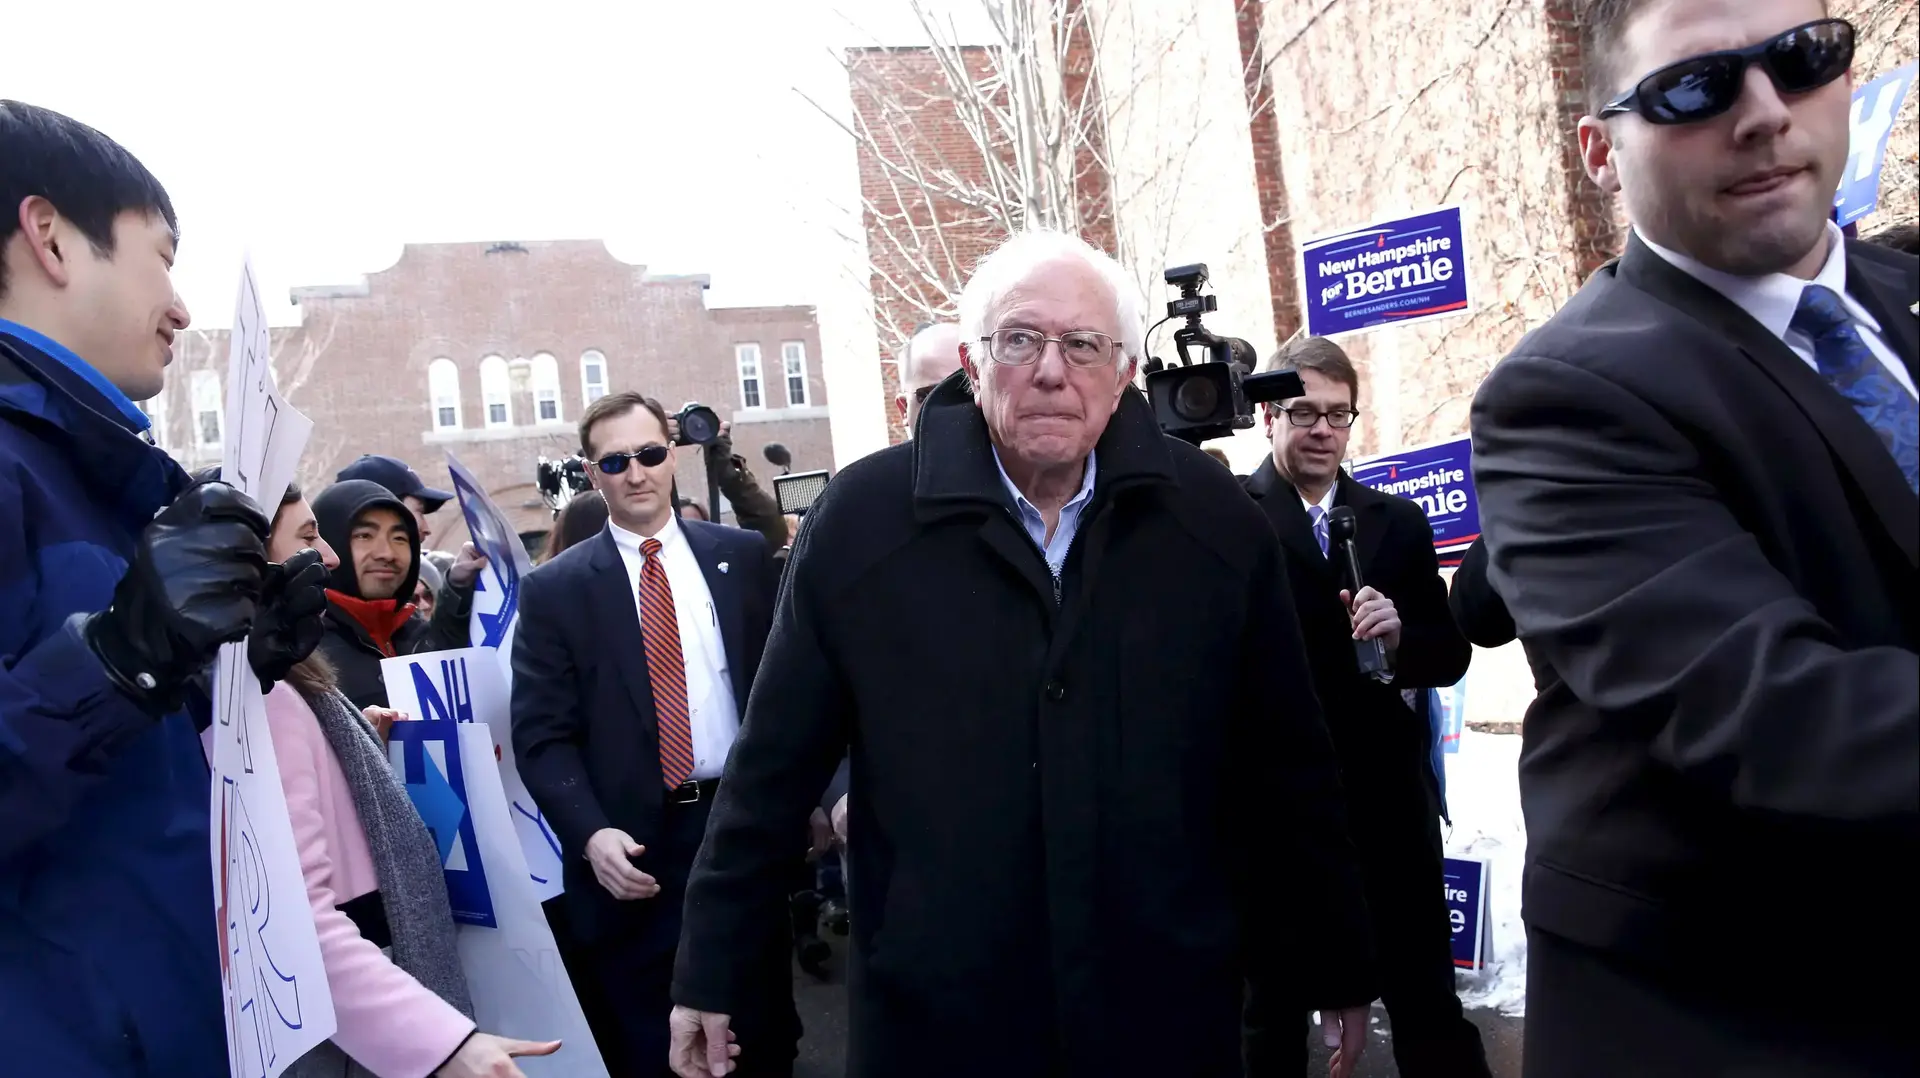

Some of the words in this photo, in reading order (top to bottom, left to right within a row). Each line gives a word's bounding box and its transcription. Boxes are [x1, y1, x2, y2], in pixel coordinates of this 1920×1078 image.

[1318, 257, 1356, 277] New
[1358, 236, 1451, 268] Hampshire
[1321, 282, 1344, 306] for
[1345, 255, 1453, 300] Bernie
